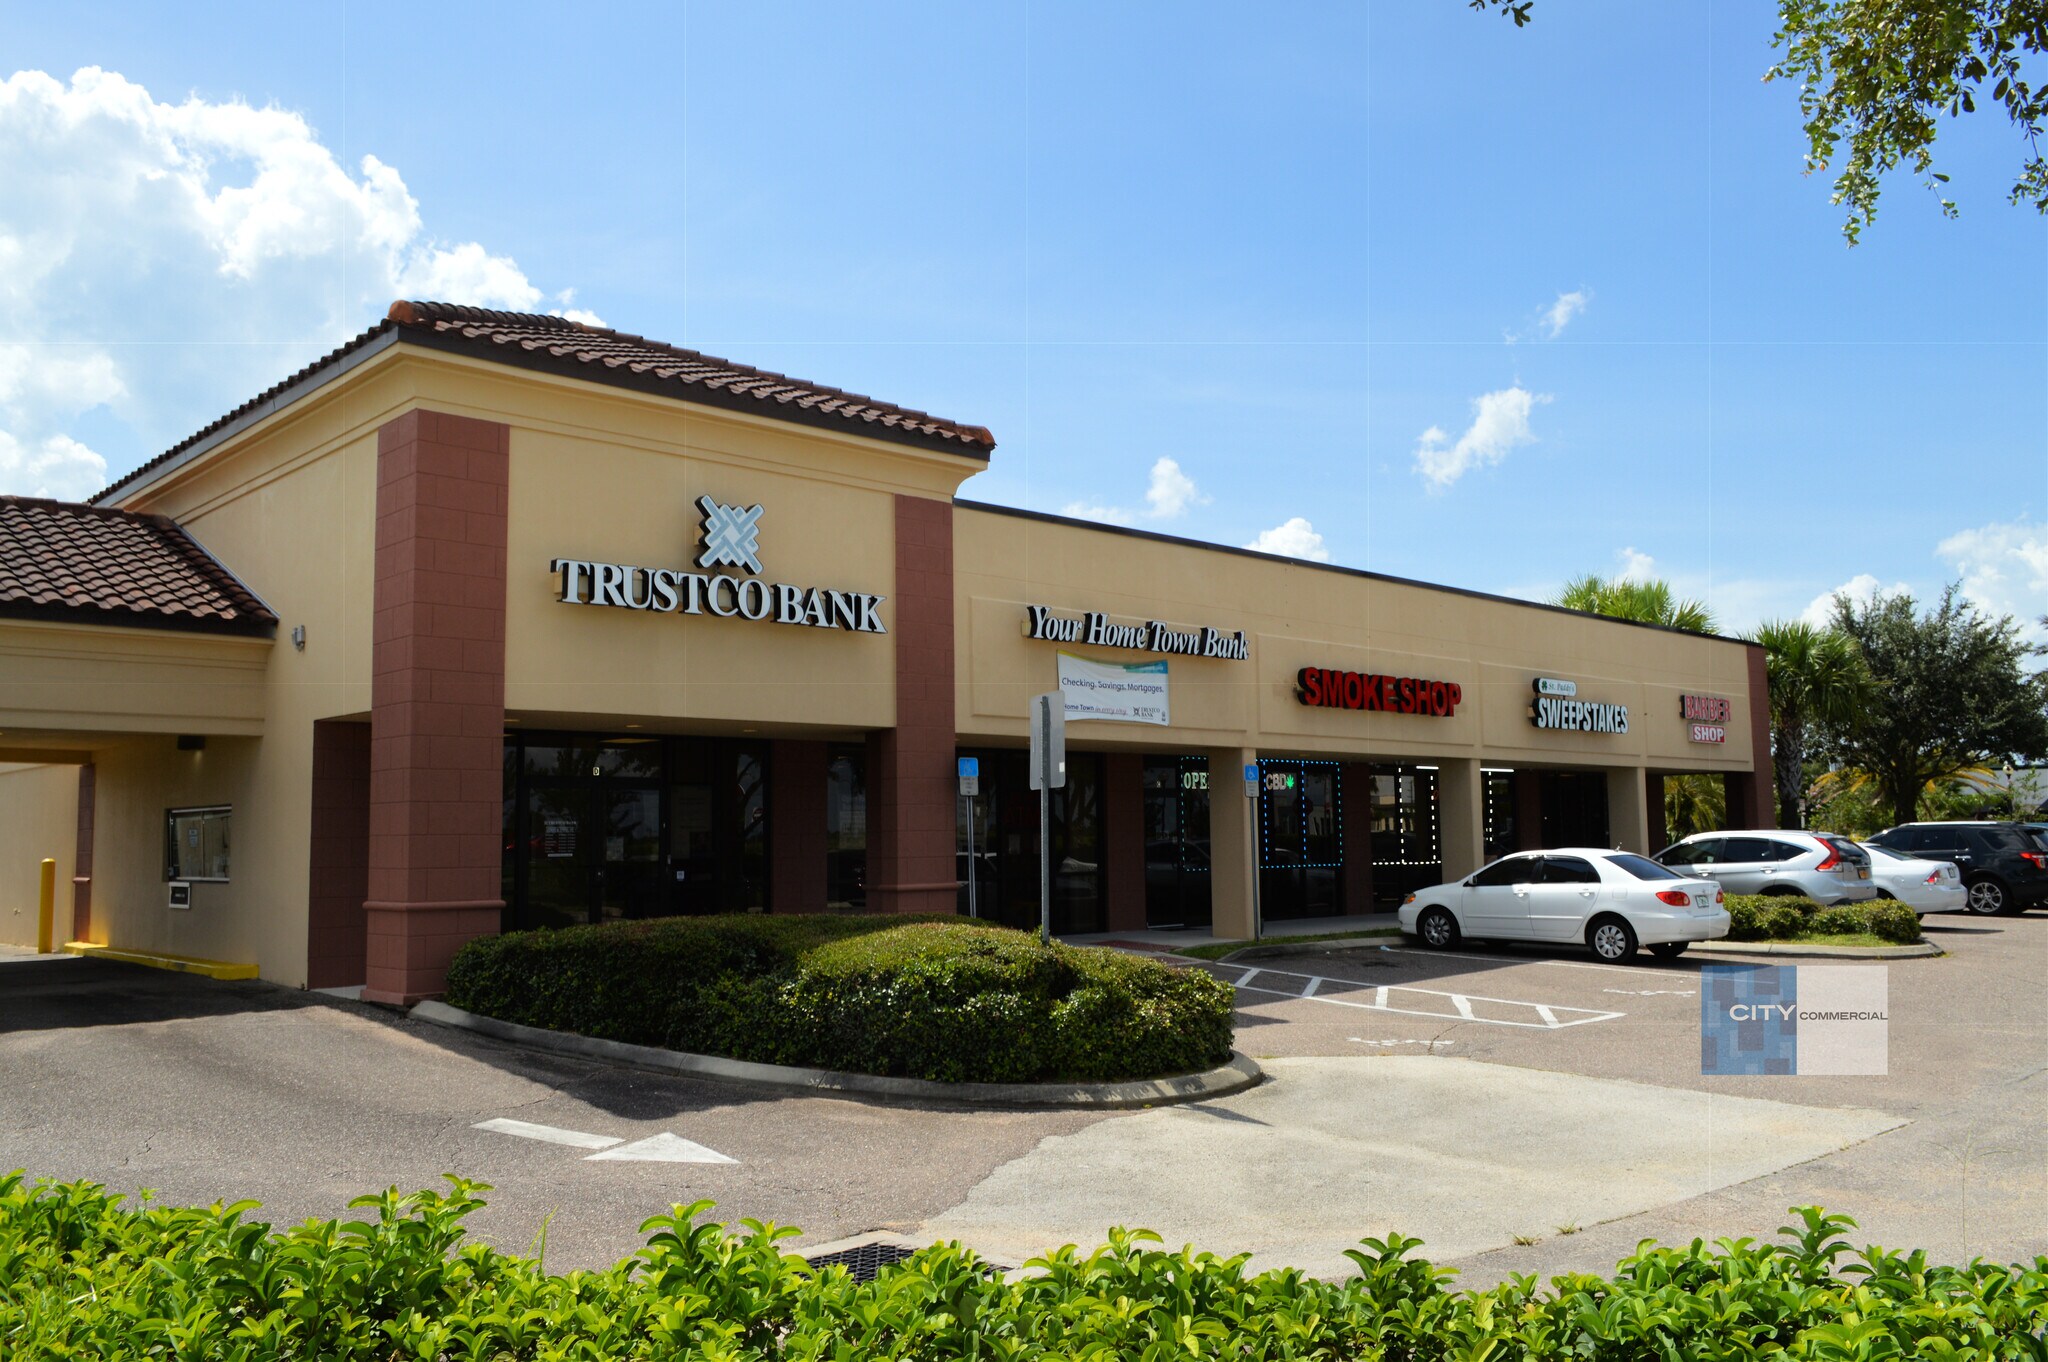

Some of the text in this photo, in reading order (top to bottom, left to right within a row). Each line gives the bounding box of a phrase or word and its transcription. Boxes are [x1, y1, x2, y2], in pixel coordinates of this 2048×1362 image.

[551, 558, 888, 634] TRUSTCO BANK
[1029, 605, 1249, 660] Your Home Town Bank
[1061, 677, 1165, 695] Checking. Savings. Mortgages.
[1300, 666, 1462, 717] SMOKE SHOP
[1536, 697, 1629, 734] SWEEPSTAKES
[1683, 695, 1731, 722] BARBER
[1694, 726, 1724, 742] SHOP
[1183, 771, 1210, 790] OPE
[1265, 773, 1287, 791] CBD
